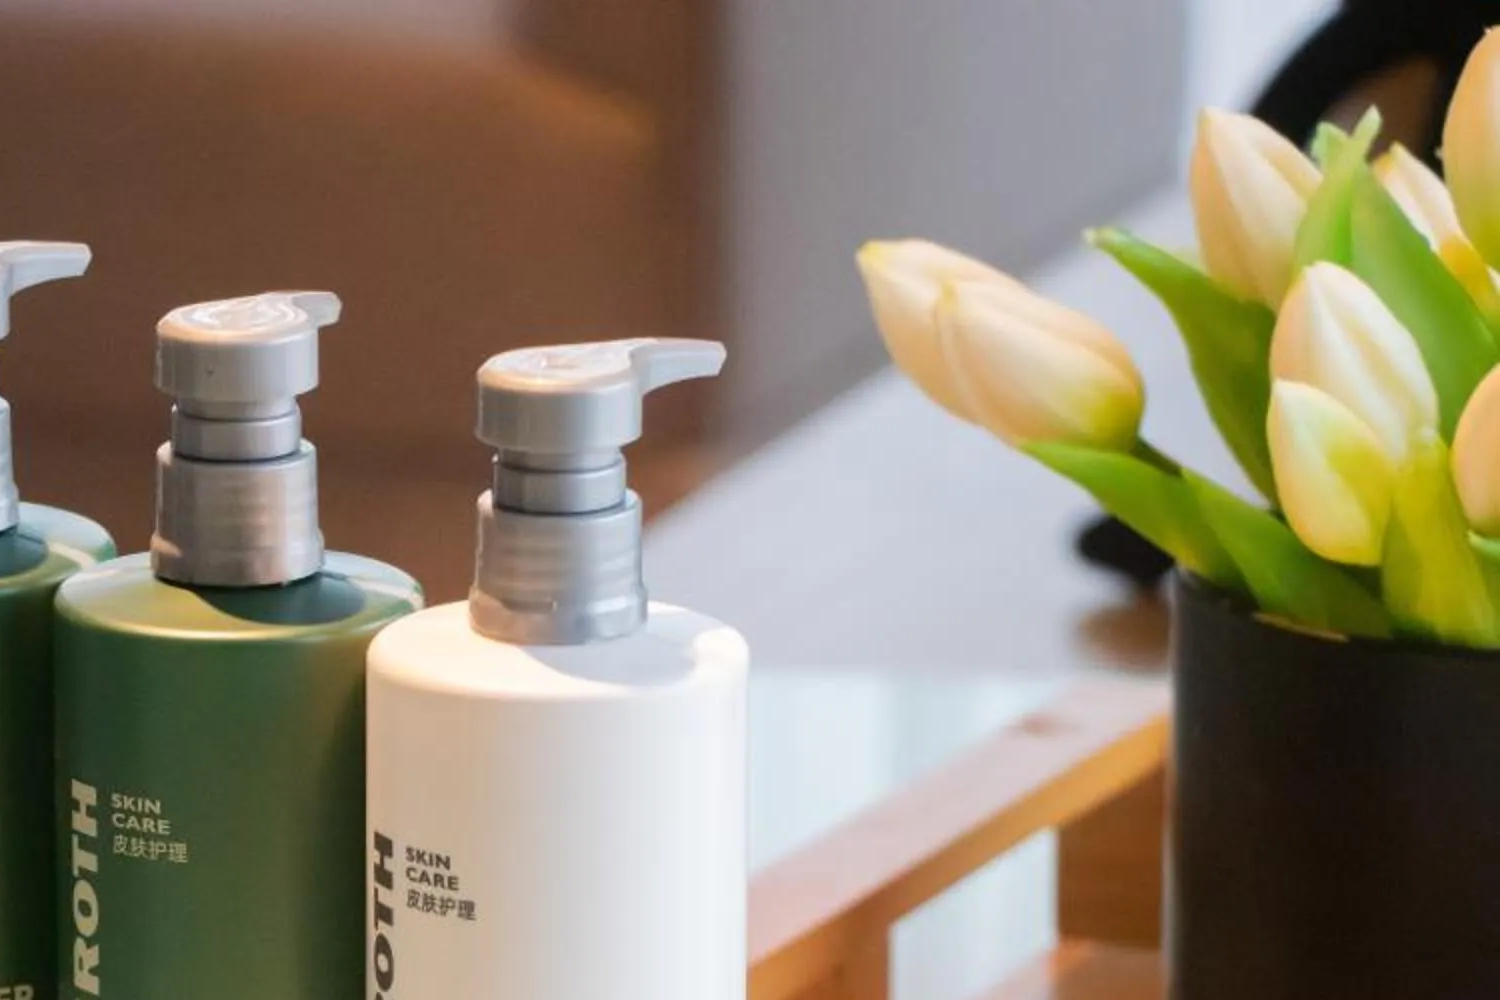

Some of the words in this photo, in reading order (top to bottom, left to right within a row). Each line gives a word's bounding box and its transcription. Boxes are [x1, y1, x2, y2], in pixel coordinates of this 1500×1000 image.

[111, 793, 161, 814] SKIN
[111, 813, 170, 836] CARE
[113, 835, 188, 863] 皮肤护理
[405, 845, 451, 870] SKIN
[406, 867, 460, 891] CARE
[407, 889, 476, 921] 皮肤护理
